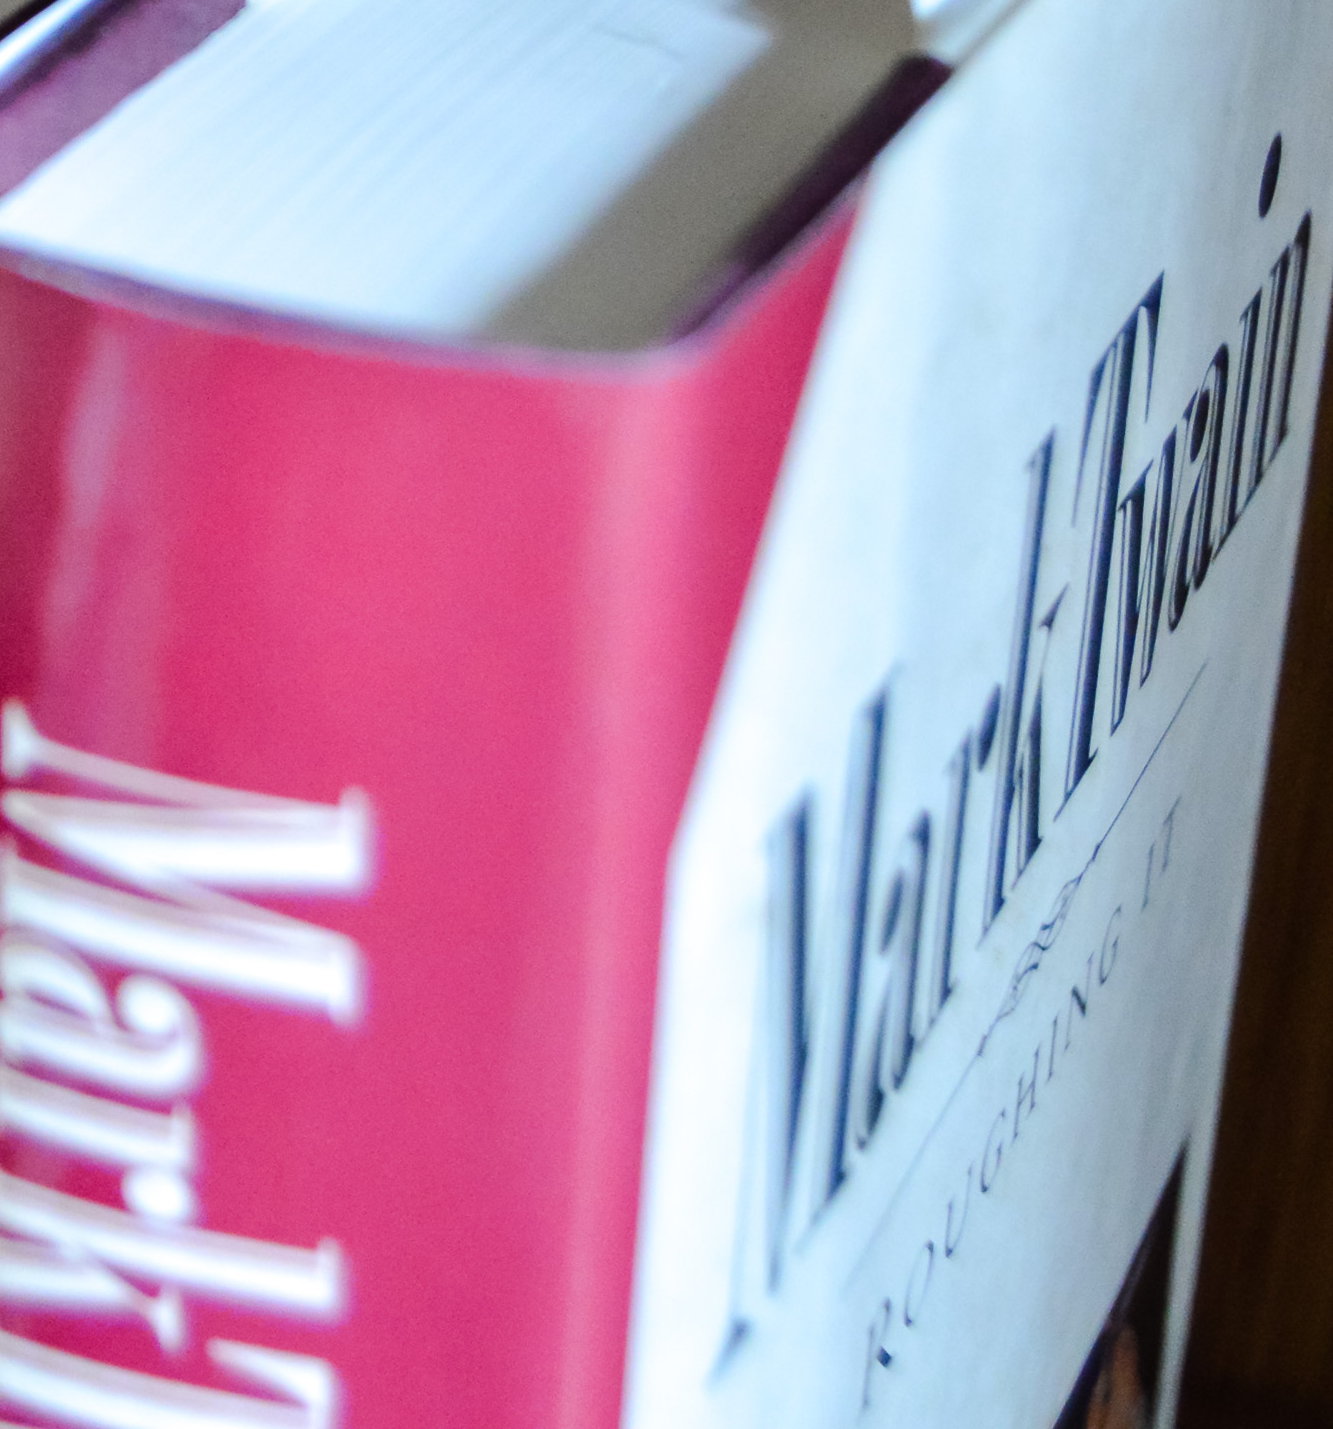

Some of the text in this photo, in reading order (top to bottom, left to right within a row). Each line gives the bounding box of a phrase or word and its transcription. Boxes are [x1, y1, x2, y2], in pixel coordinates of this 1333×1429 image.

[706, 131, 1311, 1390] Mark Twain
[861, 794, 1182, 1413] ROUGHING IT
